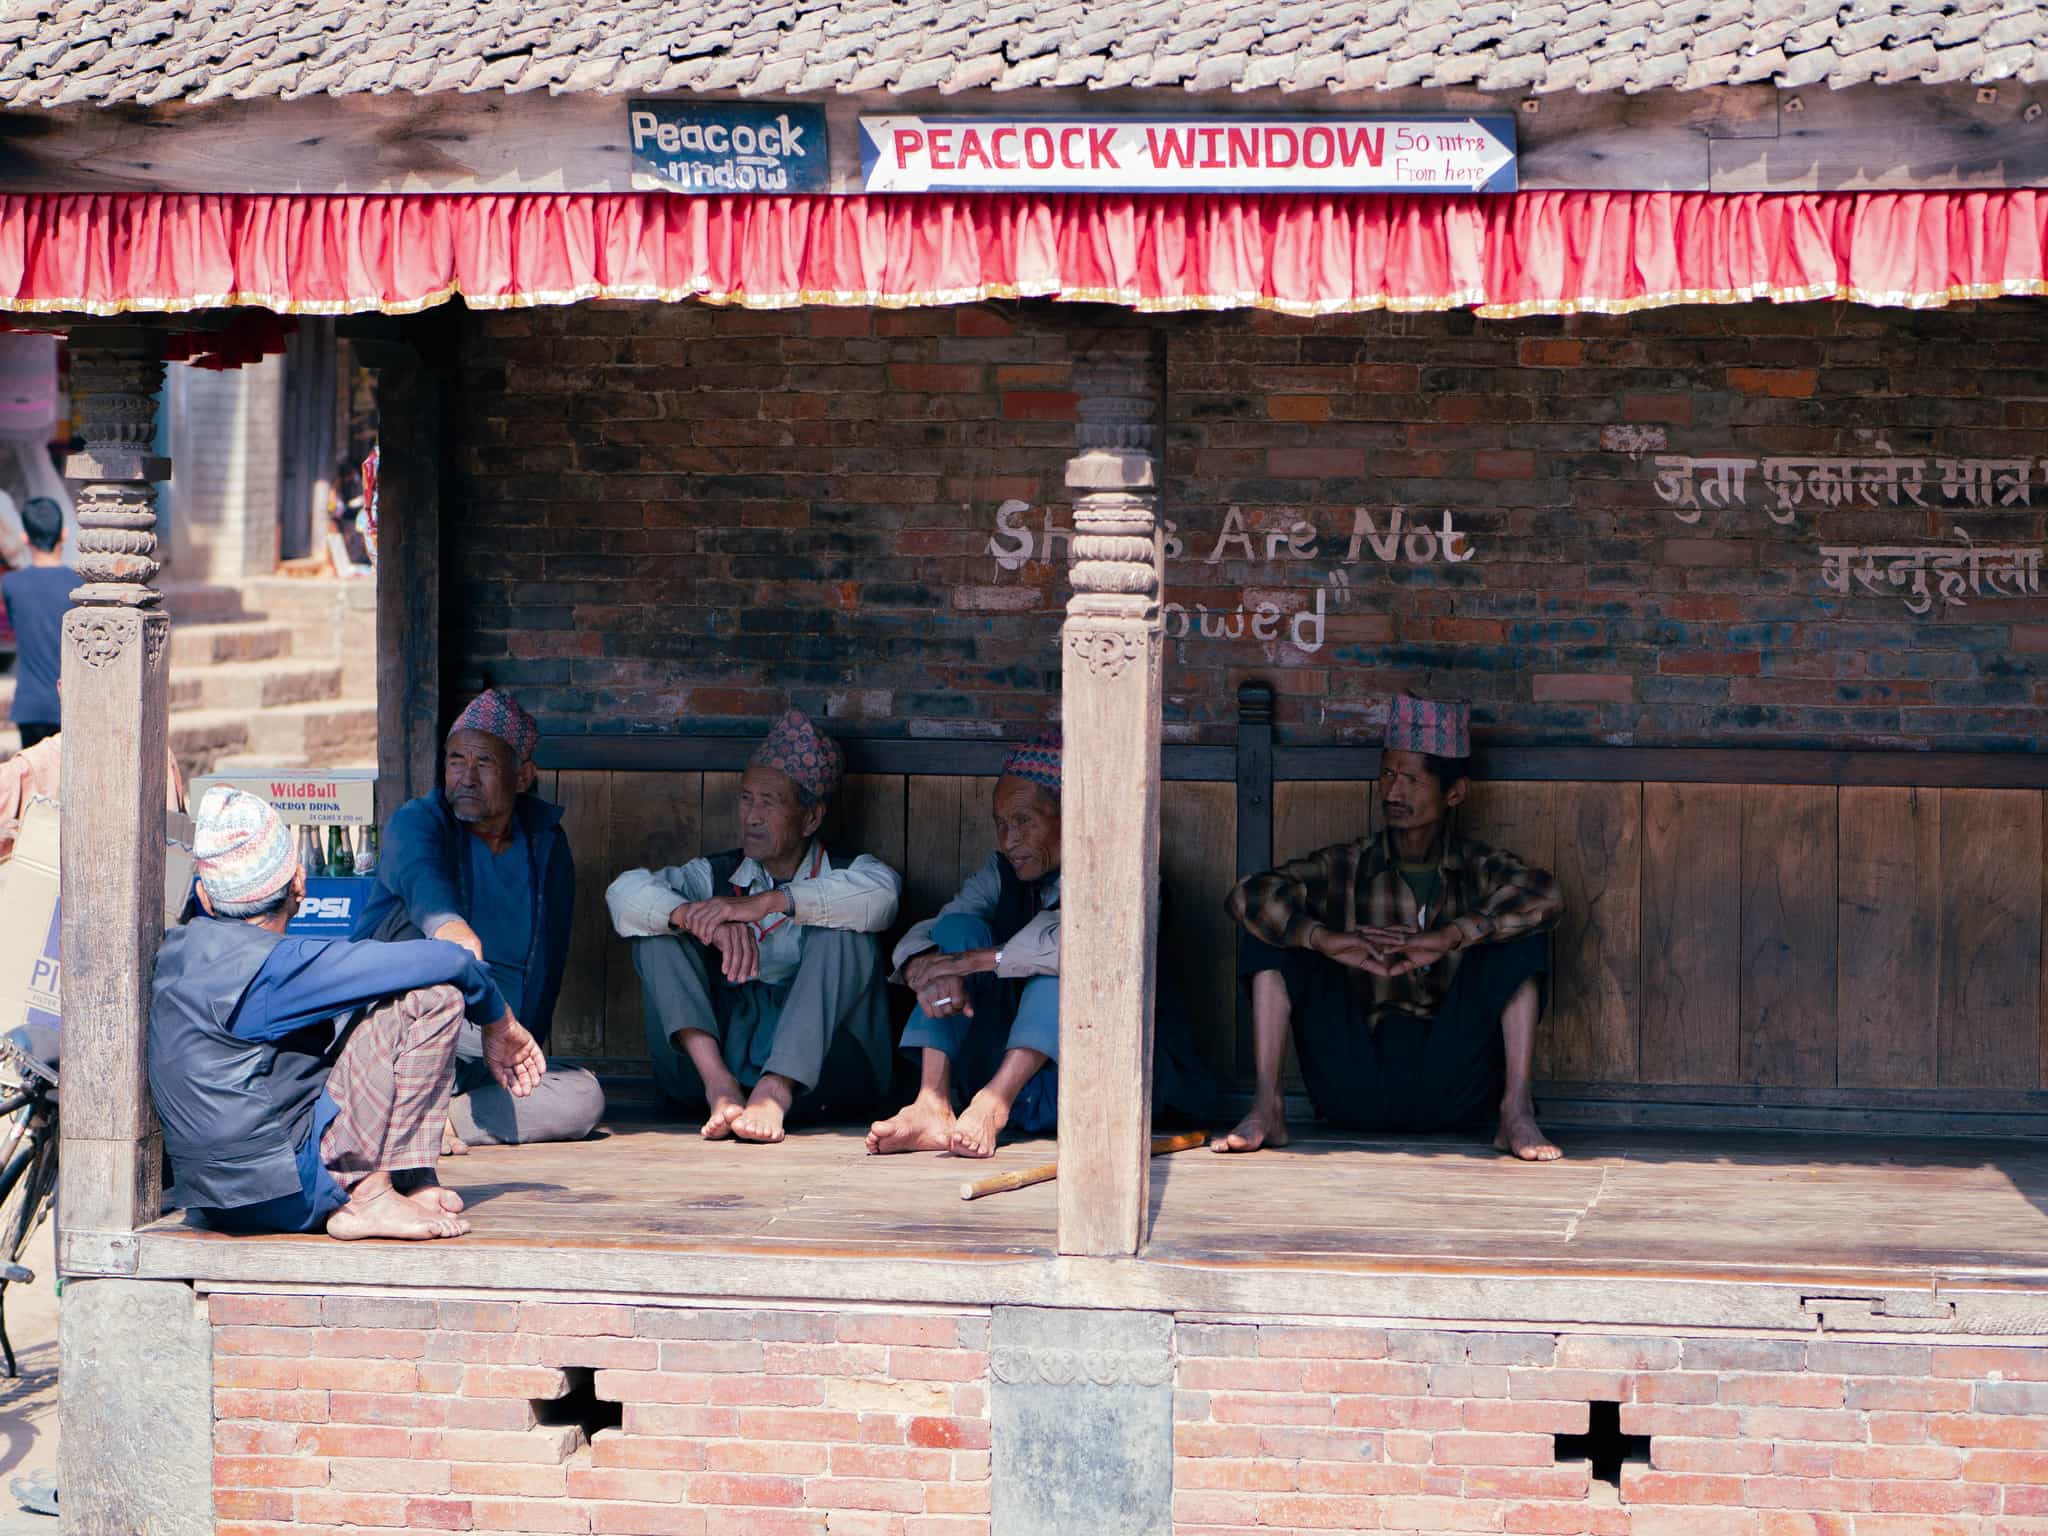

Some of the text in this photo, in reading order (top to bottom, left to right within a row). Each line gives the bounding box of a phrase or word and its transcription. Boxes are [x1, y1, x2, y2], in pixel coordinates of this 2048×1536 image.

[631, 111, 806, 157] Peacock
[893, 126, 1385, 170] PEACOCK WINDOW
[1395, 157, 1485, 182] From here
[1652, 455, 1758, 524] जुता
[1208, 505, 1319, 564] Are
[1341, 506, 1476, 563] Not
[270, 782, 337, 798] WildBull
[308, 802, 341, 812] DRINK
